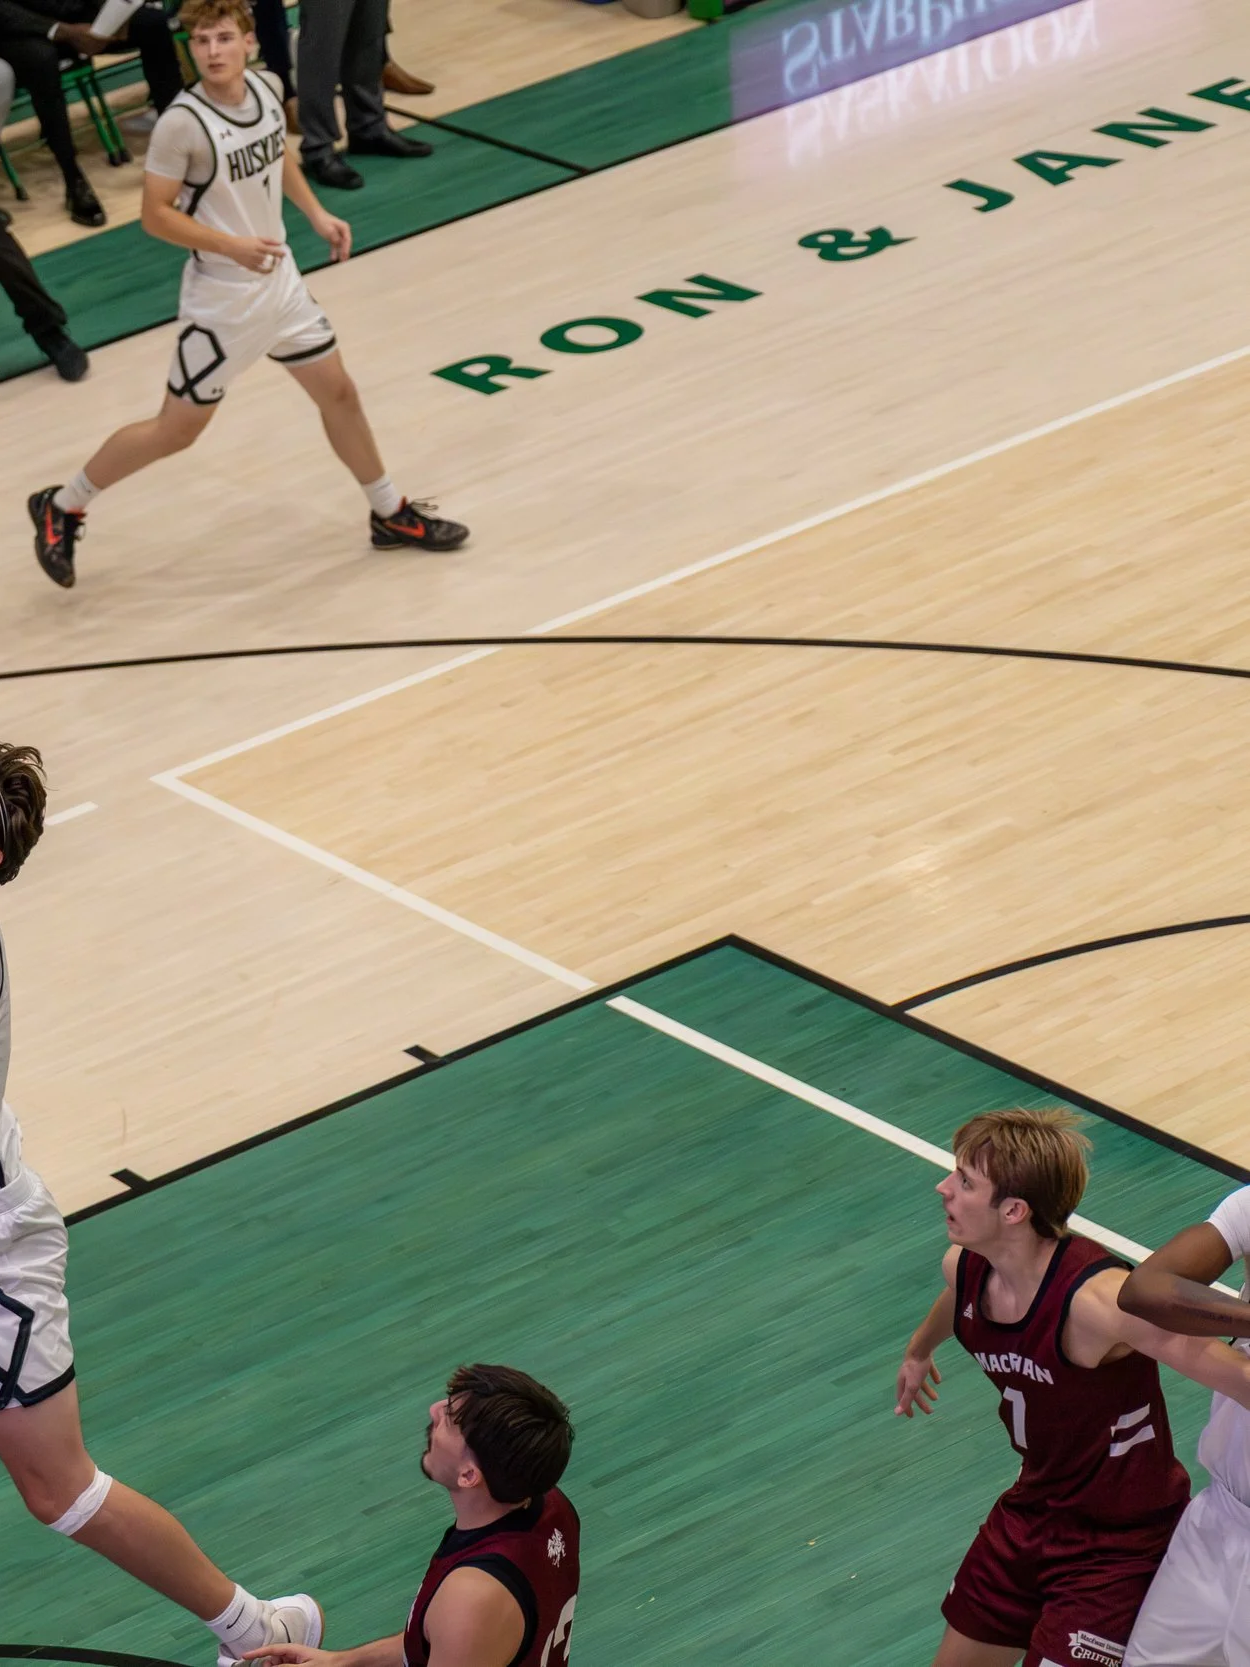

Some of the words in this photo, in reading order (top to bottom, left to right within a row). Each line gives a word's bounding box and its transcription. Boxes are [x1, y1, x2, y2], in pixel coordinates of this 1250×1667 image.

[431, 273, 764, 396] RON
[797, 226, 918, 263] &
[943, 76, 1250, 214] JANE
